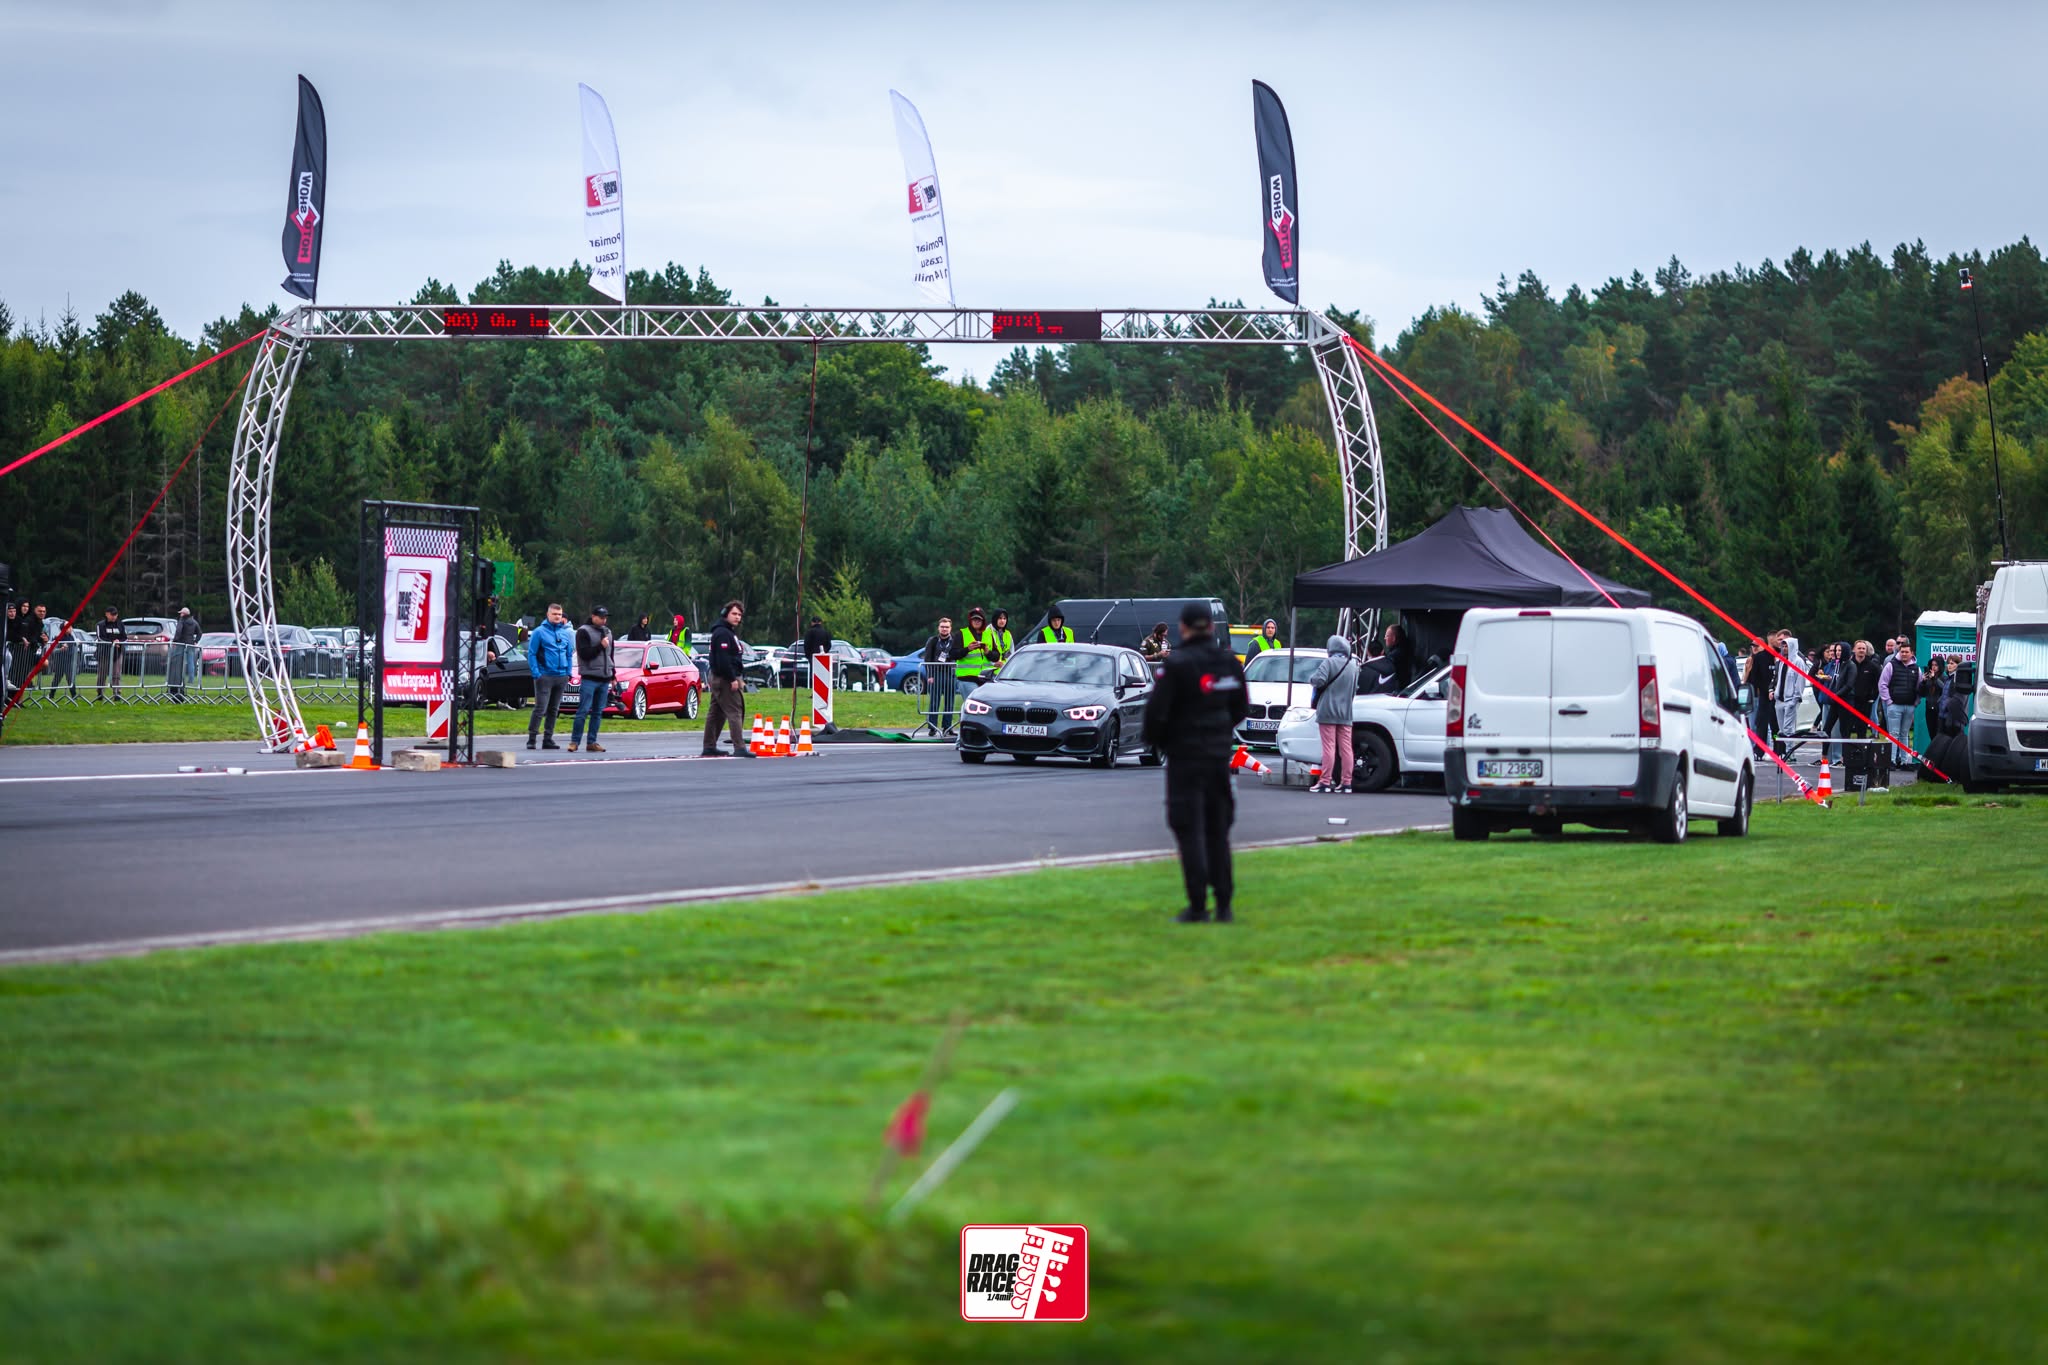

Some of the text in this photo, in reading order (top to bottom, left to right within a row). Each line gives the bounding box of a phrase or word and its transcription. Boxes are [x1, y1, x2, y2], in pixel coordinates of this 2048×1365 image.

[386, 671, 437, 692] www.dragrace.pl
[1007, 725, 1045, 735] WZ 140HA
[1484, 762, 1540, 775] NGI 23858
